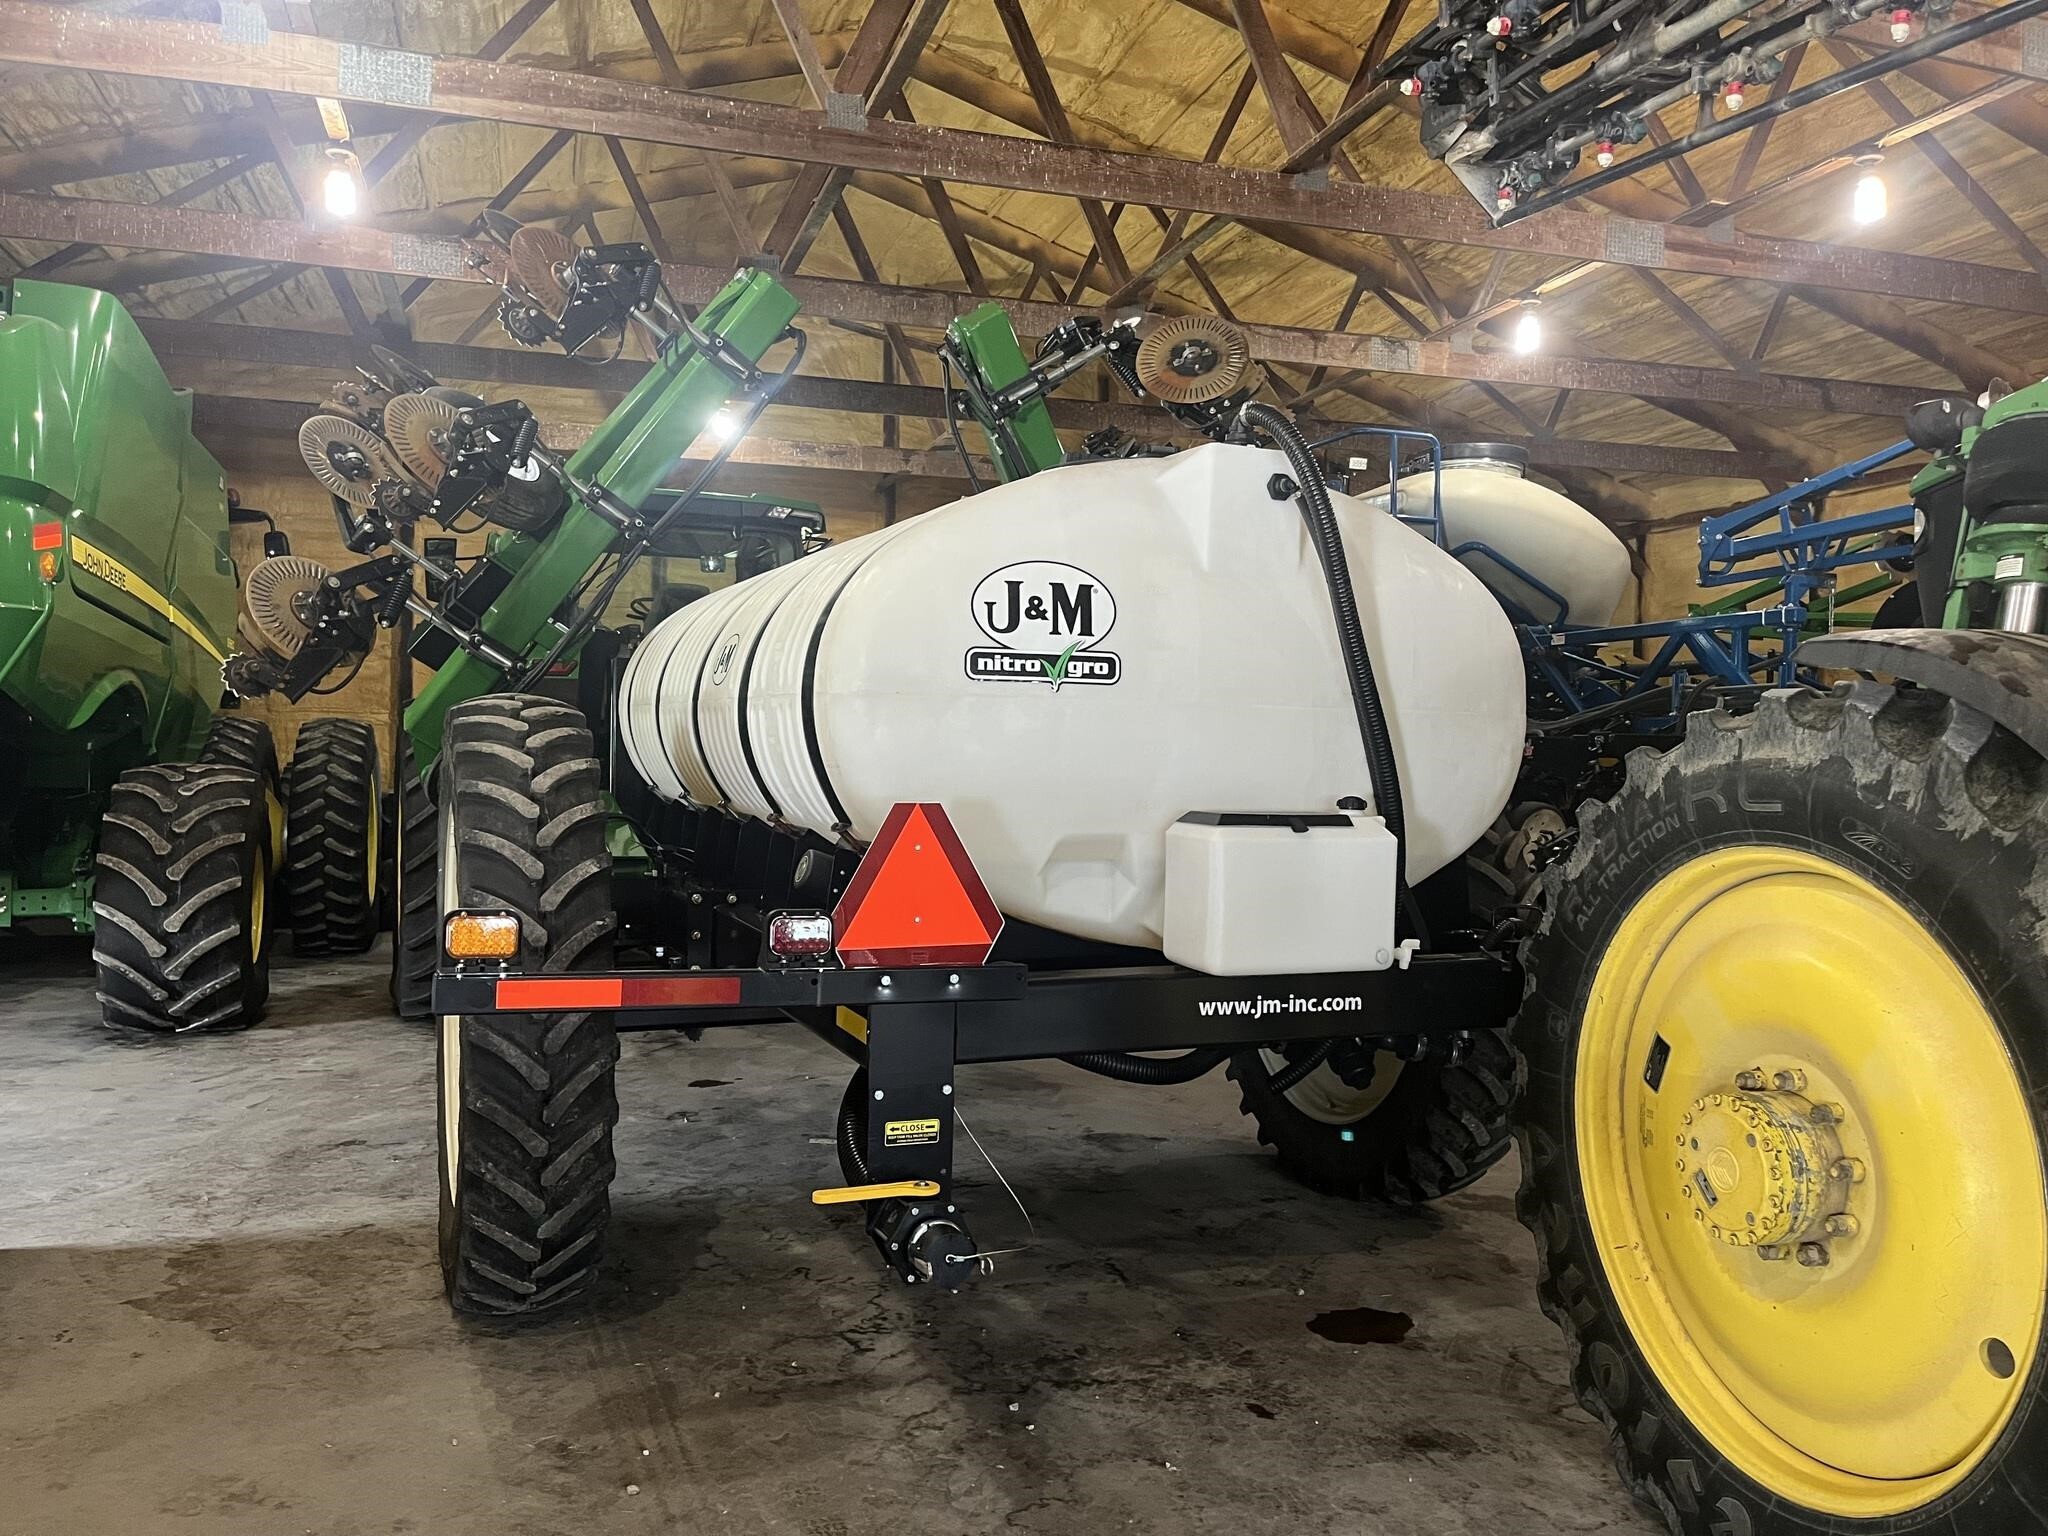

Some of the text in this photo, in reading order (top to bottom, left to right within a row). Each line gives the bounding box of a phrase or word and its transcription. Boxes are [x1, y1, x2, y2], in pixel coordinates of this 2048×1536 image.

[83, 548, 127, 590] JOHN DEERE
[984, 580, 1095, 637] J&M
[977, 655, 1109, 678] nitro gro
[1575, 813, 1681, 932] ALL TRACTION
[1198, 993, 1362, 1020] www.jm-inc.com
[900, 1123, 925, 1132] CLOSE
